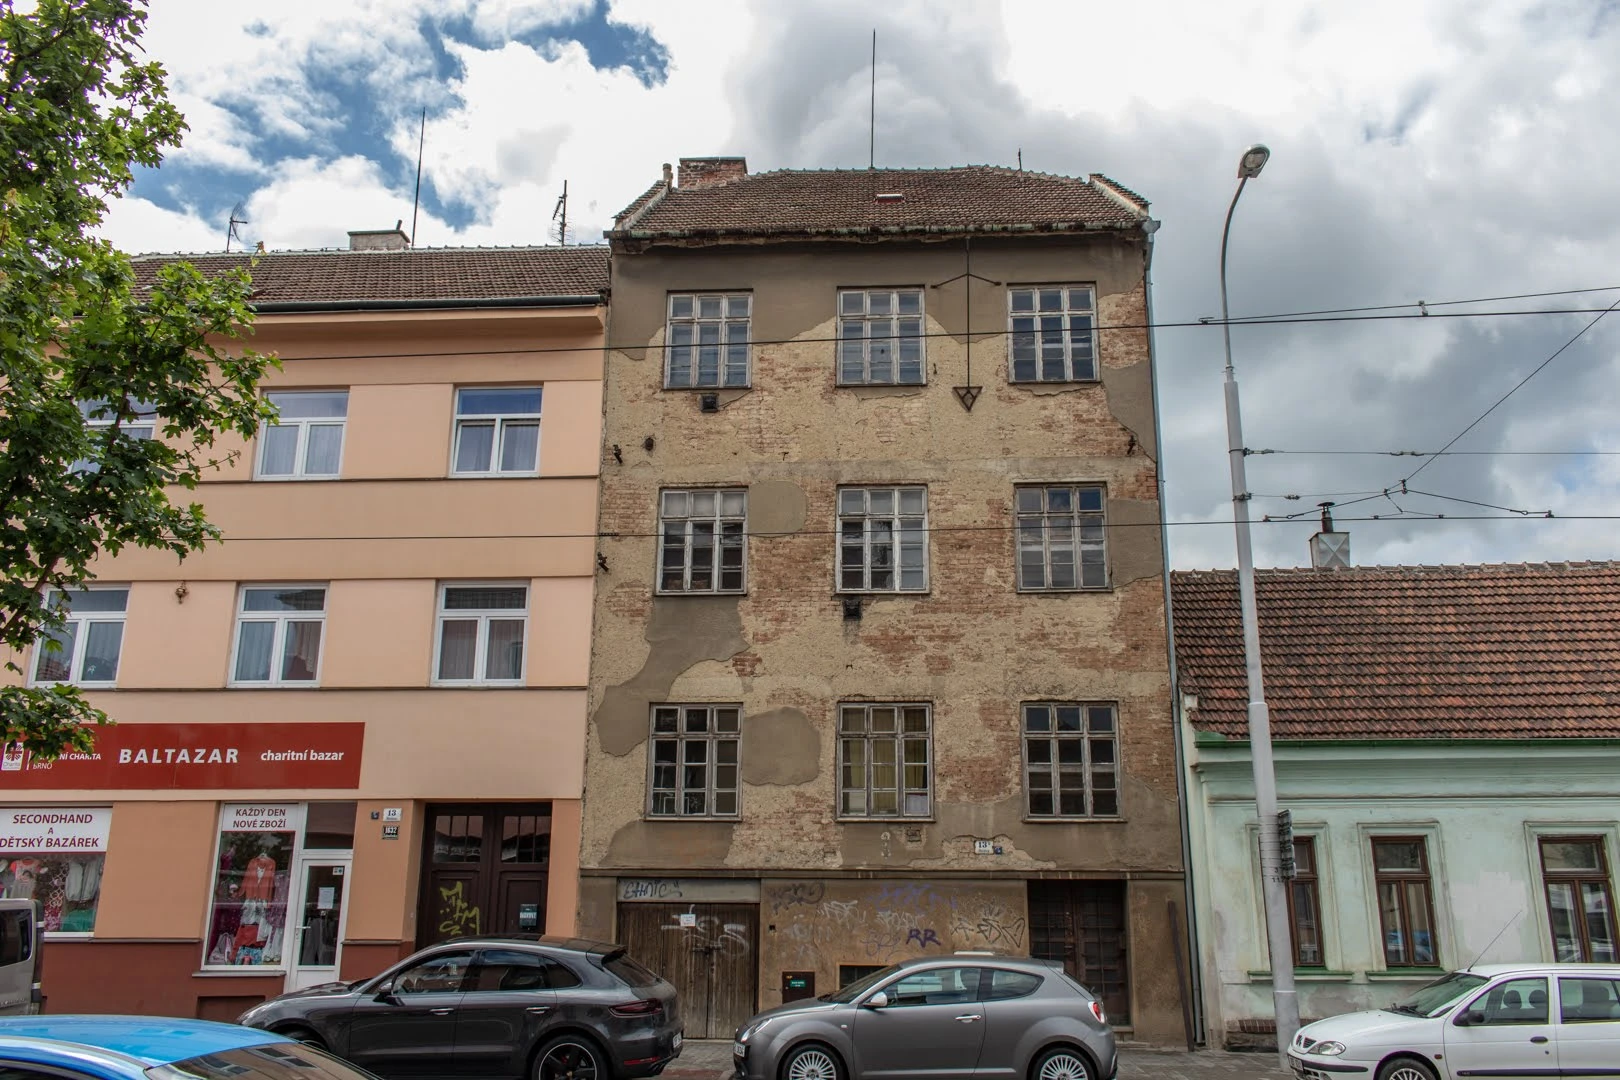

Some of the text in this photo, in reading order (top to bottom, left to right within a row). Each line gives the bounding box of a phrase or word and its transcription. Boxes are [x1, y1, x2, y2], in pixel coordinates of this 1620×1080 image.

[69, 752, 101, 760] CHARTA
[119, 748, 239, 764] BALTAZAR
[260, 749, 344, 761] charitní bazar
[235, 807, 286, 817] KAŽDÝ DEN
[387, 809, 397, 817] 13
[13, 814, 93, 824] SECONDHAND
[232, 818, 287, 828] NOVÉ ZBOŽÍ
[0, 836, 99, 848] DĚTSKÝ BAZÁREK
